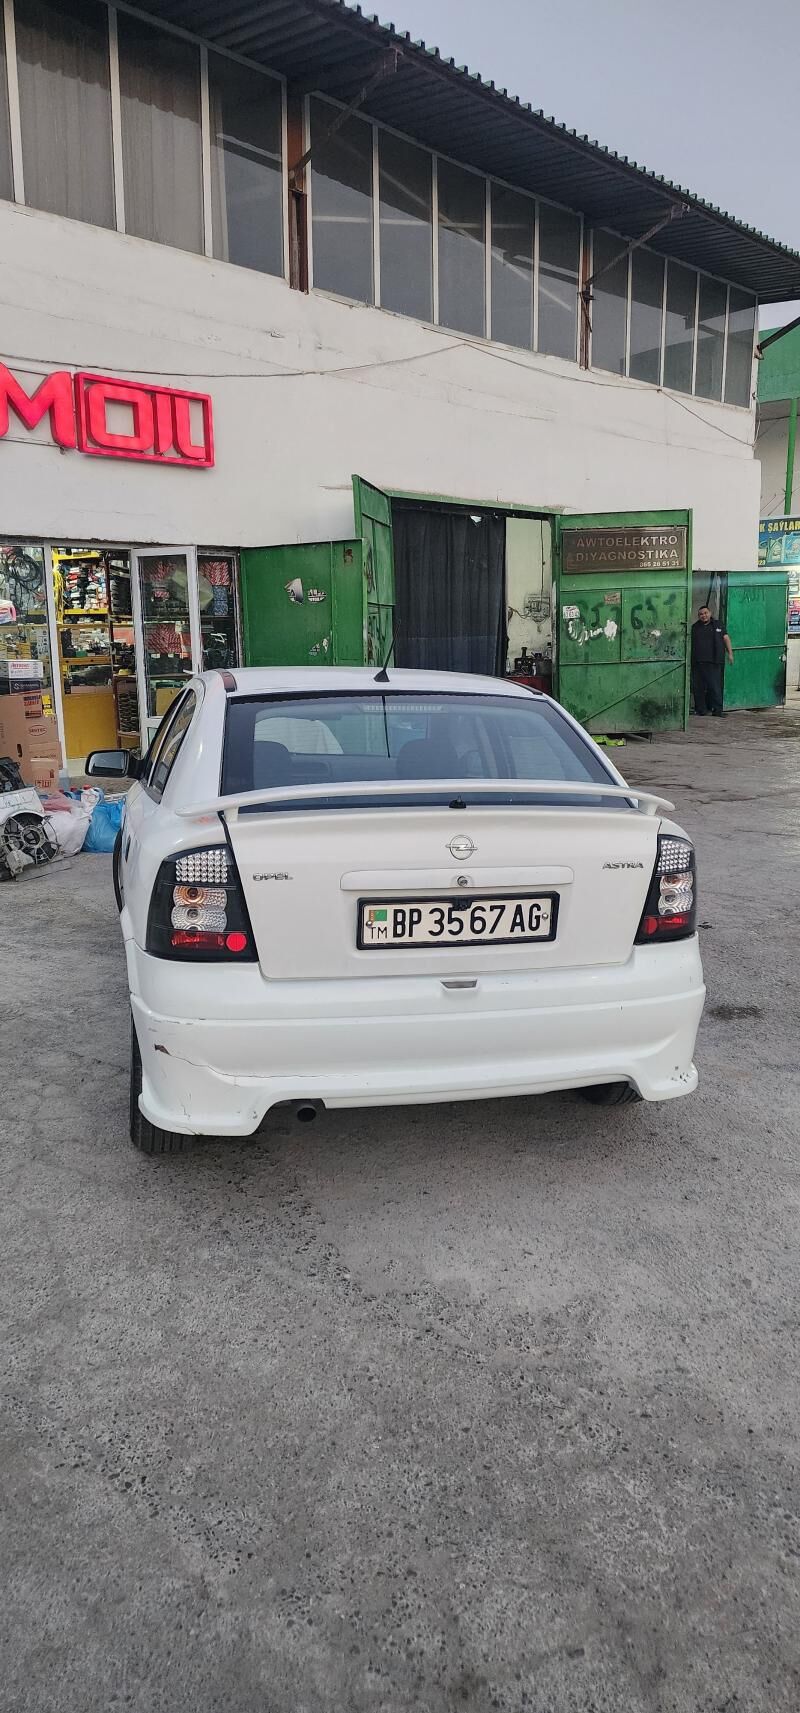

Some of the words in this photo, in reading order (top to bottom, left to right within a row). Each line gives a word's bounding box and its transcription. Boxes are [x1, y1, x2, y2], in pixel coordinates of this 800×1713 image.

[576, 535, 678, 548] AWTOELEKTRO
[576, 549, 679, 561] DIYAGNOSTIKA
[602, 861, 644, 870] ASTRA
[252, 872, 294, 881] OPEL
[370, 926, 388, 939] TM
[392, 908, 422, 938] BP
[509, 903, 542, 933] AG
